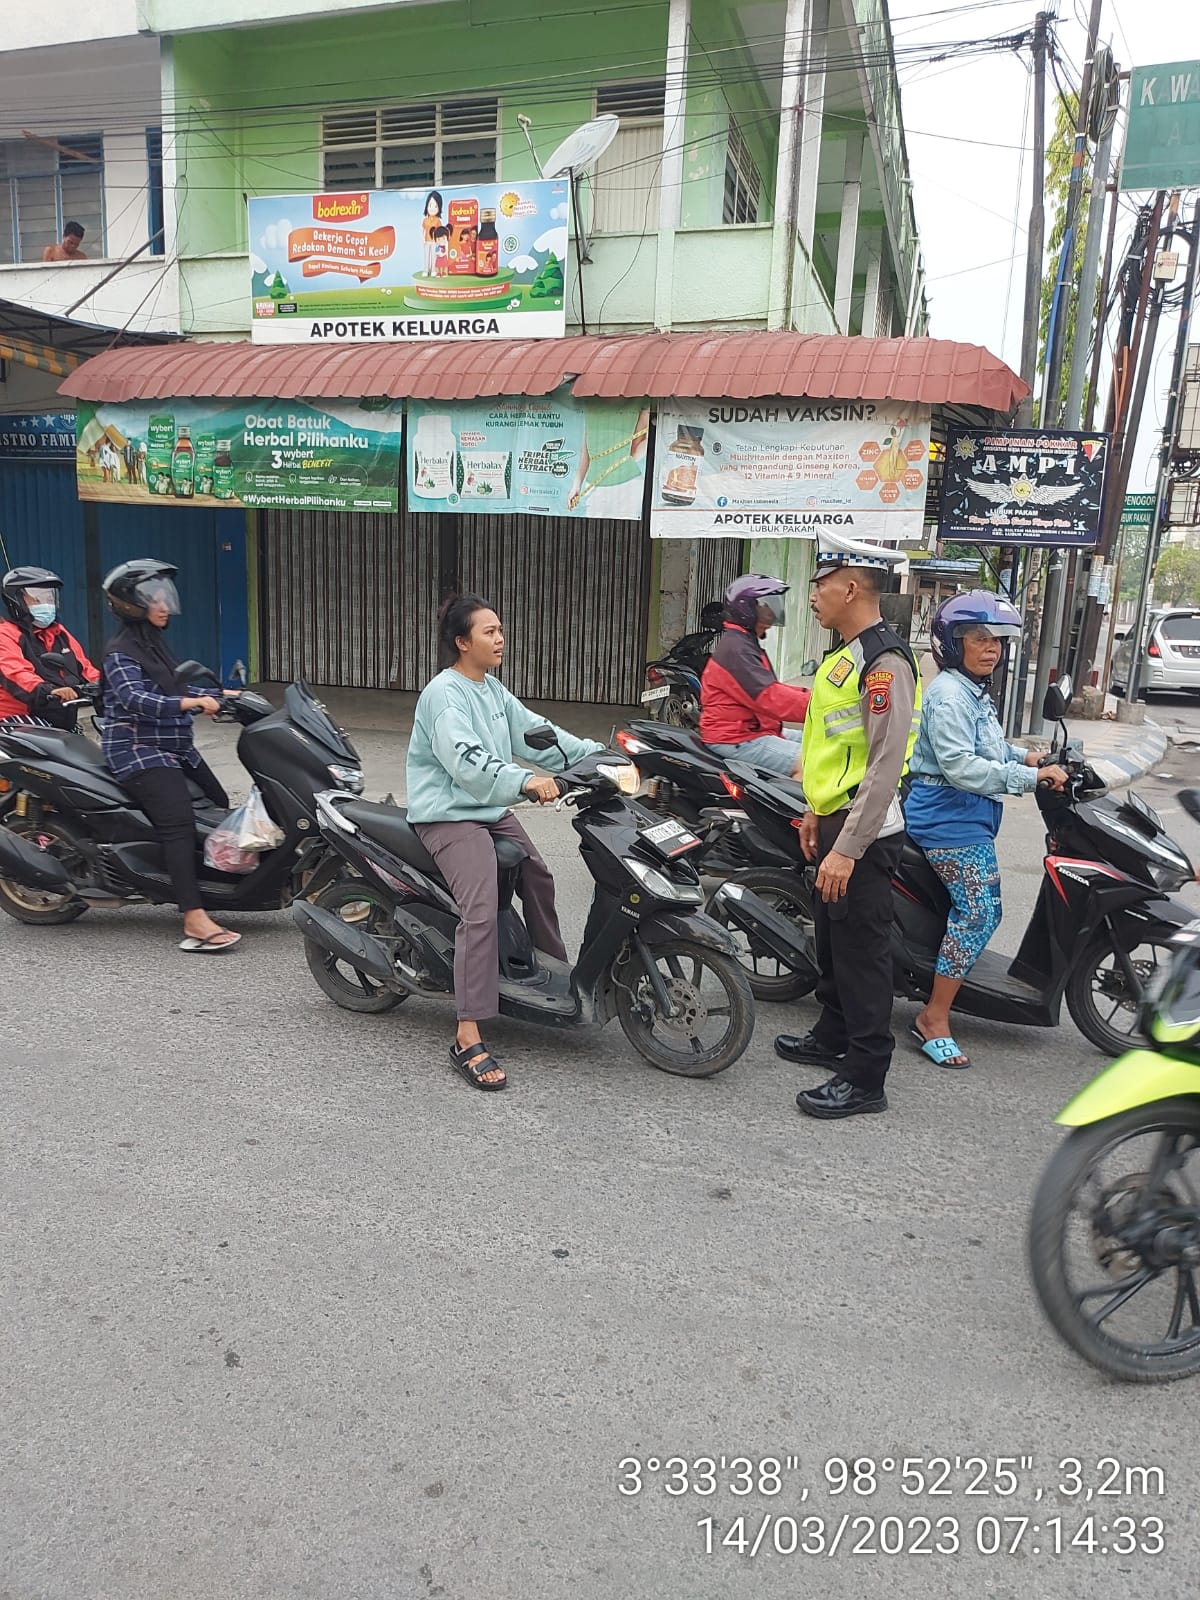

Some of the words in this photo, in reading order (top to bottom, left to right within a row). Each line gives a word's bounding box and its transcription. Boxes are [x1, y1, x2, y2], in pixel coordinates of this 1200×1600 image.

[317, 200, 361, 218] bodrexin
[313, 230, 342, 244] Bekerja
[345, 234, 368, 245] Cepat
[292, 242, 325, 254] Redakan
[327, 244, 356, 256] Demam
[358, 248, 366, 256] Si
[368, 245, 389, 256] Kecil
[310, 321, 385, 338] APOTEK
[392, 318, 500, 337] KELUARGA
[708, 407, 779, 423] SUDAH
[785, 404, 876, 422] VAKSIN?
[244, 414, 283, 429] Obat
[287, 414, 331, 430] Batuk
[150, 424, 174, 434] wybert
[243, 431, 293, 447] Herbal
[297, 432, 369, 449] Pilihanku
[984, 436, 1035, 447] PIMPINAN
[735, 444, 757, 452] Tetap
[760, 443, 798, 452] Lengkapi
[800, 443, 845, 451] Kebutuhan
[271, 450, 283, 469] 3
[283, 449, 314, 460] wybert
[523, 450, 550, 459] TRIPLE
[729, 453, 780, 461] Multivitamin
[782, 453, 813, 462] dengan
[419, 457, 449, 465] Herbalax
[466, 461, 503, 470] Herbalax
[518, 458, 550, 466] HERBAL
[719, 465, 738, 473] yang
[740, 464, 794, 472] mengandung
[796, 463, 831, 471] Ginseng
[754, 472, 785, 480] Vitamin
[803, 472, 835, 480] Mineral
[242, 494, 346, 507] #WybertHerbalPilihanku
[713, 514, 773, 525] APOTEK
[775, 514, 855, 525] KELUARGA
[750, 525, 780, 533] LUBUK
[782, 525, 815, 533] PAKAM
[1058, 866, 1090, 887] HONDA
[621, 905, 641, 919] YAMAHA
